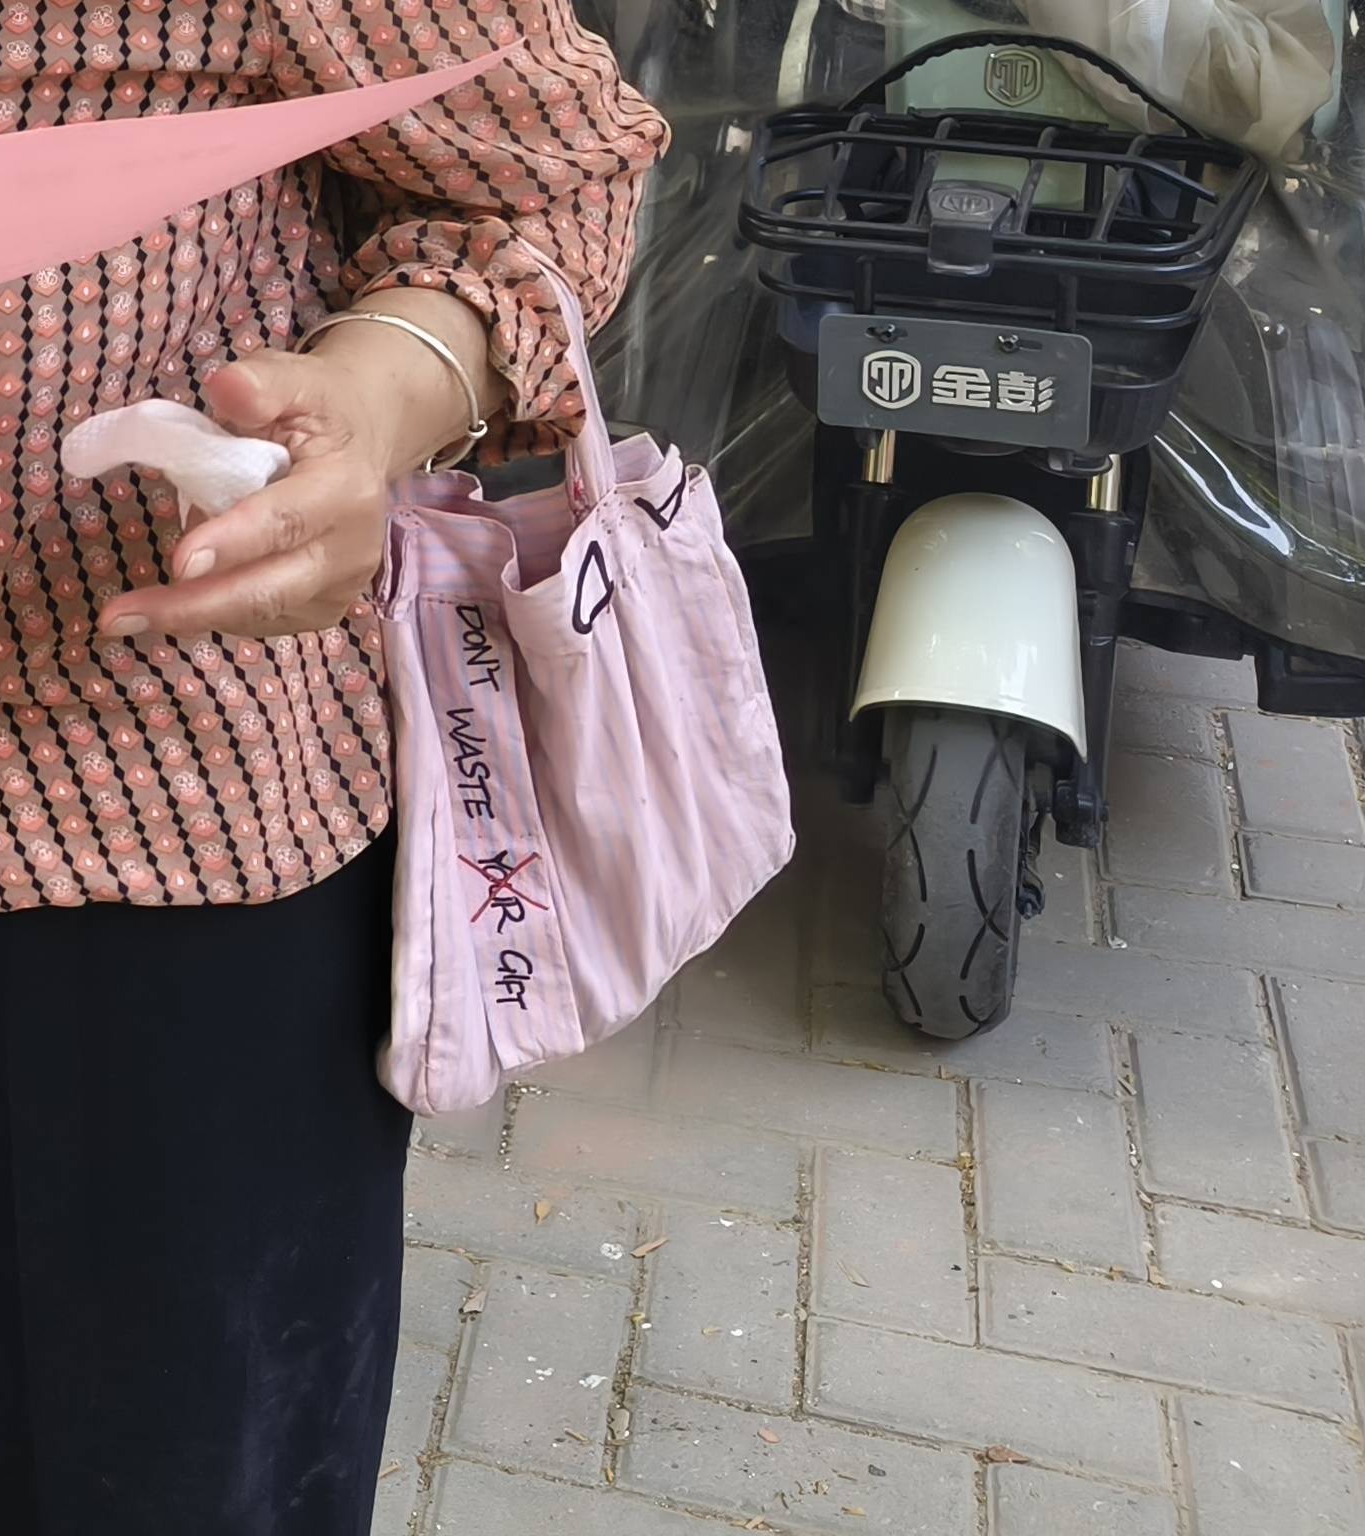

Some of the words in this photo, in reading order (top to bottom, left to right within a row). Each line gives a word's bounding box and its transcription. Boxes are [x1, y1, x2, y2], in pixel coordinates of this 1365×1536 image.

[932, 365, 1056, 413] 金彭
[456, 604, 500, 692] DON'T
[446, 707, 495, 819] WASTE
[495, 950, 533, 1010] GIFT
